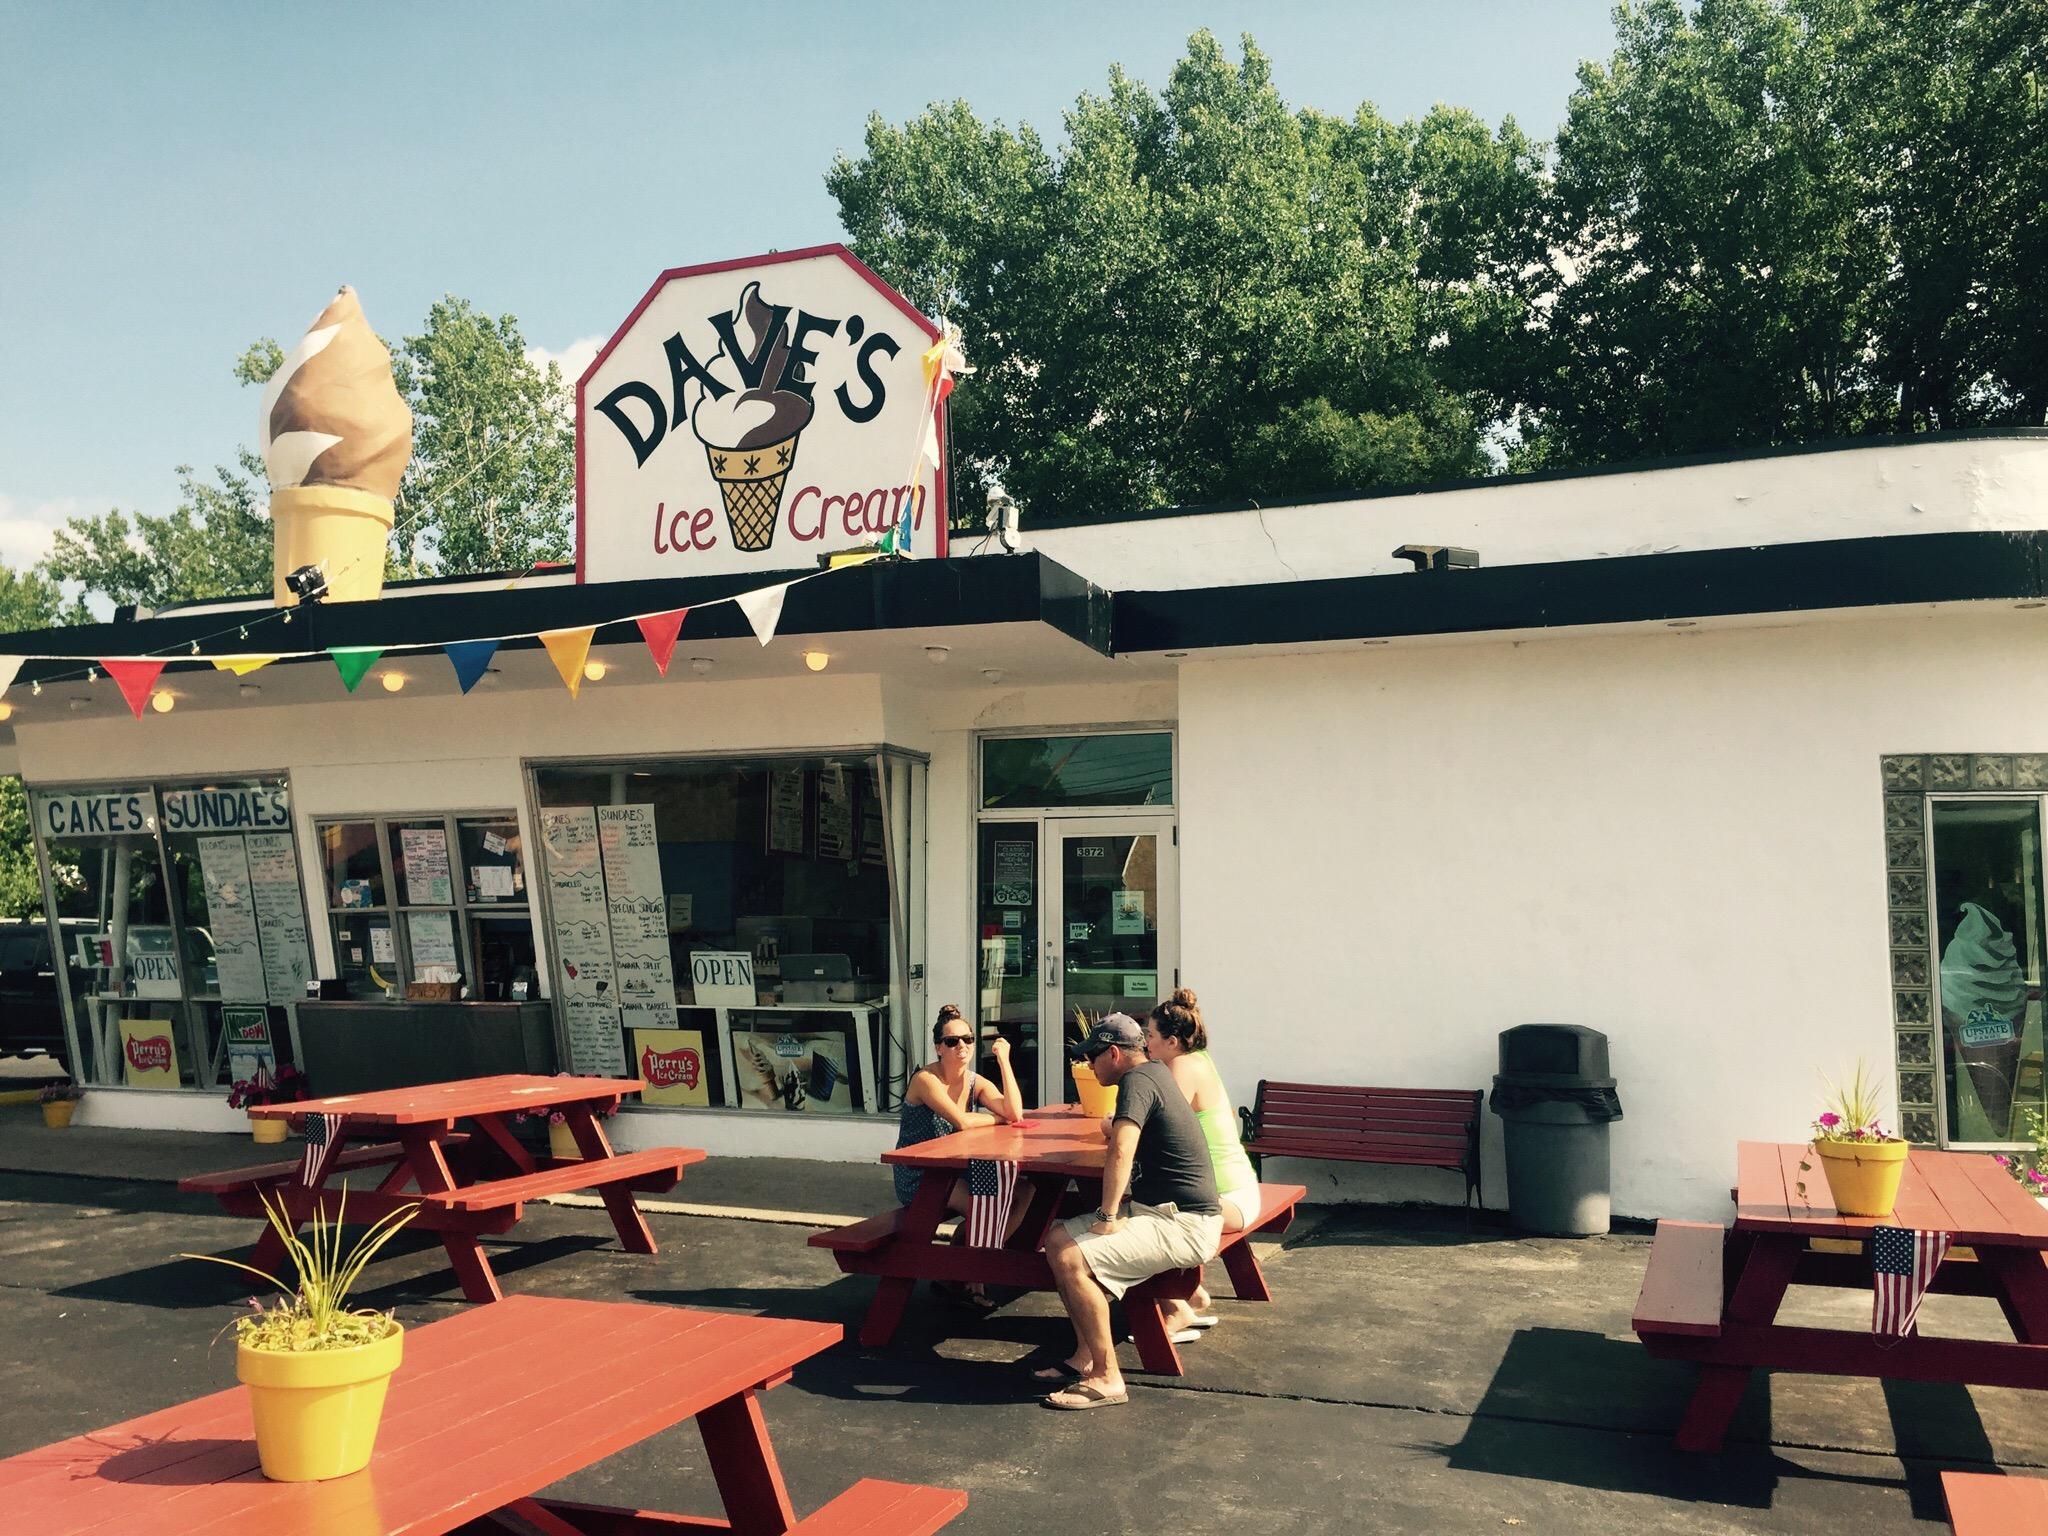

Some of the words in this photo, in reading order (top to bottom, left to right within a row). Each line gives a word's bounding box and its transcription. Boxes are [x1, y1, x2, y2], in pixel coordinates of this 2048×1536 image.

[594, 304, 901, 469] DAVE'S
[654, 502, 717, 554] Ice
[788, 484, 926, 542] Cream
[48, 796, 144, 834] CAKES
[166, 790, 288, 829] SUNDAES
[600, 808, 645, 821] SUNDAES
[135, 956, 178, 981] OPEN
[693, 958, 751, 986] OPEN
[1965, 1024, 2009, 1038] UPSTATE
[131, 1041, 167, 1060] Perry's
[648, 1054, 693, 1076] Perry's
[656, 1070, 668, 1081] Ice
[668, 1069, 693, 1081] Cream
